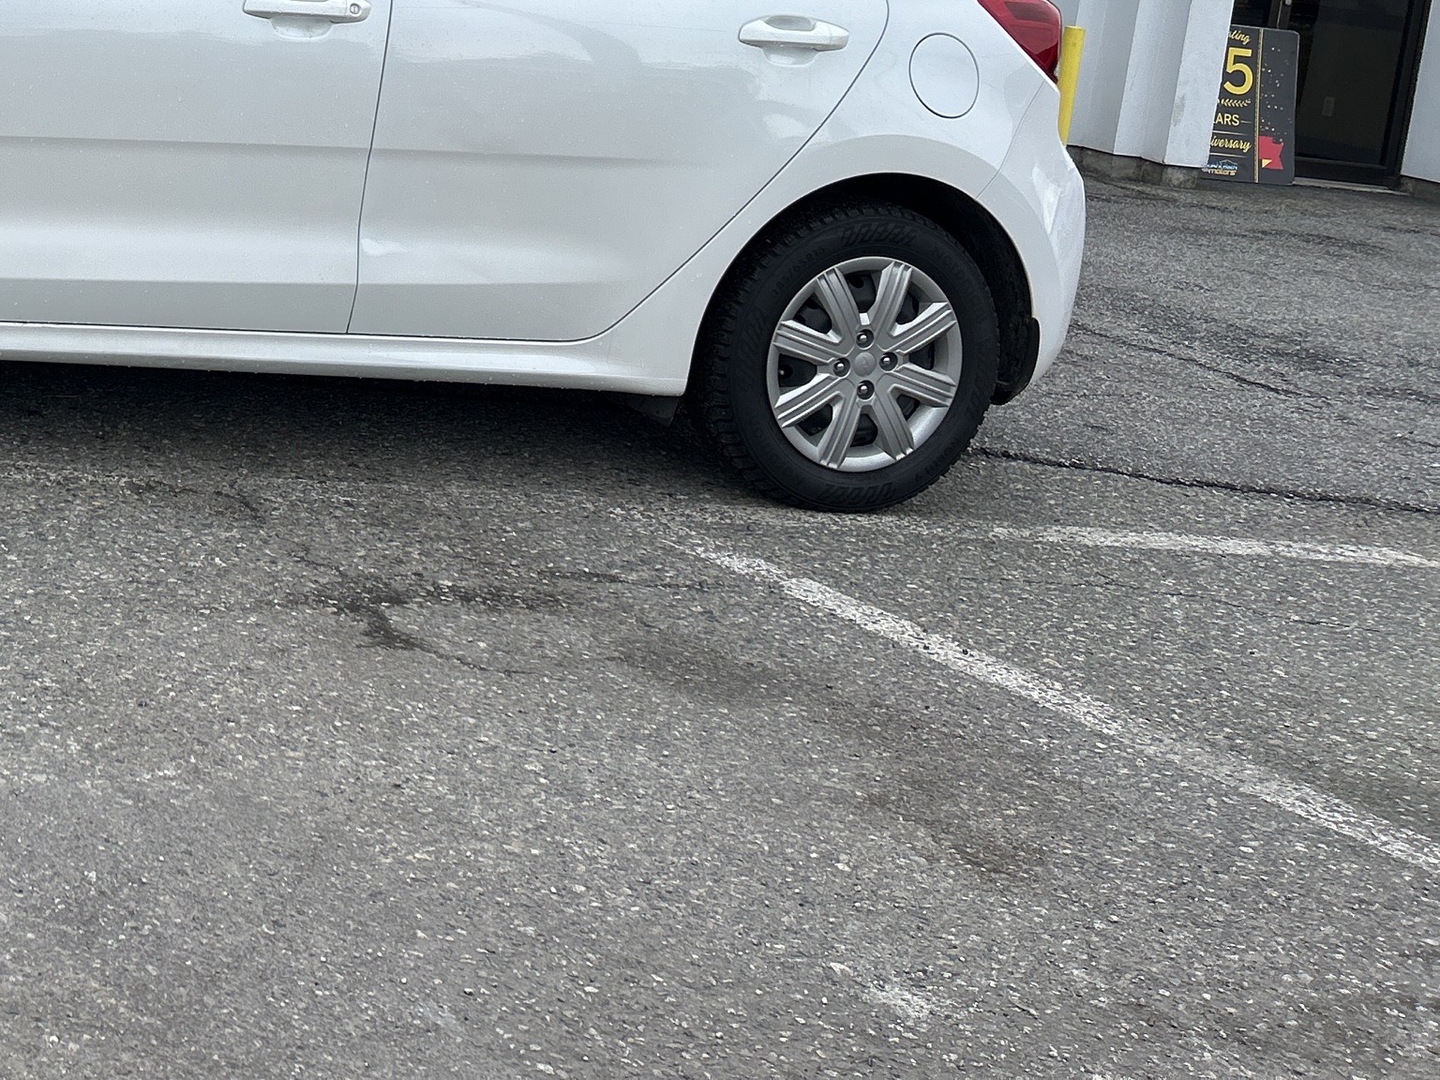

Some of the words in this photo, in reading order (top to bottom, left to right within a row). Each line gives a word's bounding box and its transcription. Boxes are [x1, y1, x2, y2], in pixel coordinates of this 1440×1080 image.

[1223, 47, 1253, 95] 5
[1213, 113, 1240, 126] ARS
[1210, 135, 1252, 153] iversary
